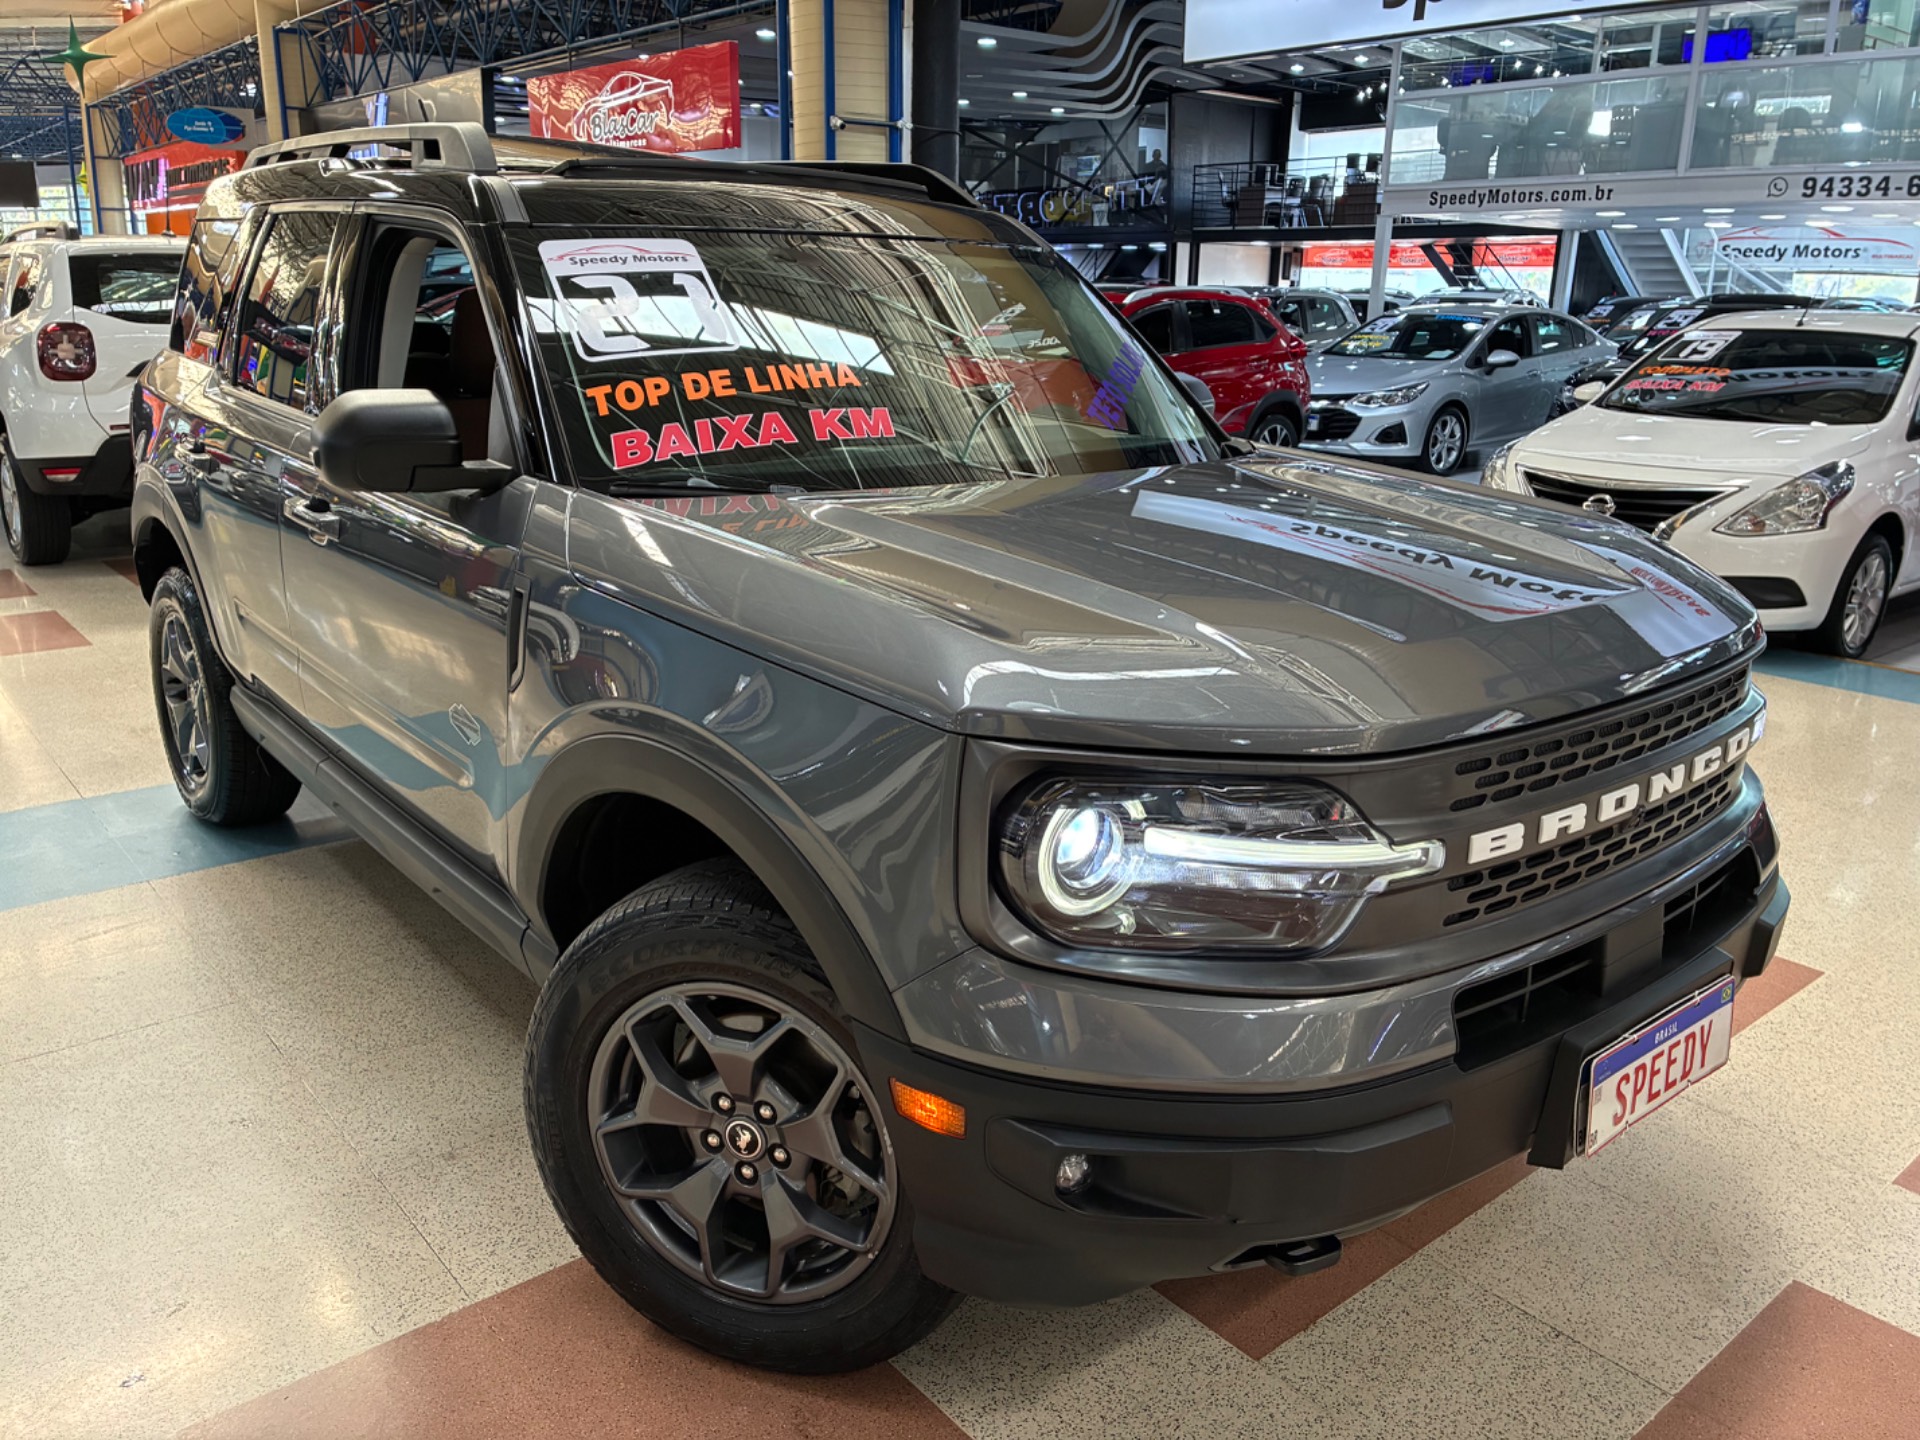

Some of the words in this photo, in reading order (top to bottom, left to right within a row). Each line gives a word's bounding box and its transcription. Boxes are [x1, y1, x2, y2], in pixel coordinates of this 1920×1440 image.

[591, 108, 660, 141] BlasCar
[1429, 185, 1614, 208] SpeedyMotors.com.br
[1801, 175, 1920, 198] 94334-6
[569, 254, 629, 266] Speedy
[632, 253, 689, 264] Motors
[1721, 244, 1788, 262] Speedy
[1792, 244, 1861, 259] Motors
[1679, 340, 1726, 359] 19
[1638, 366, 1732, 376] COMPLETO
[587, 376, 671, 416] TOP
[681, 369, 737, 400] DE
[745, 362, 861, 393] LINHA
[1624, 379, 1685, 390] BAIXA
[1687, 380, 1726, 392] KM
[611, 411, 798, 470] BAIXA
[810, 407, 896, 442] KM
[1467, 726, 1751, 865] BRONCO
[1654, 1021, 1678, 1044] BRASIL
[1612, 1019, 1713, 1127] SPEEDY
